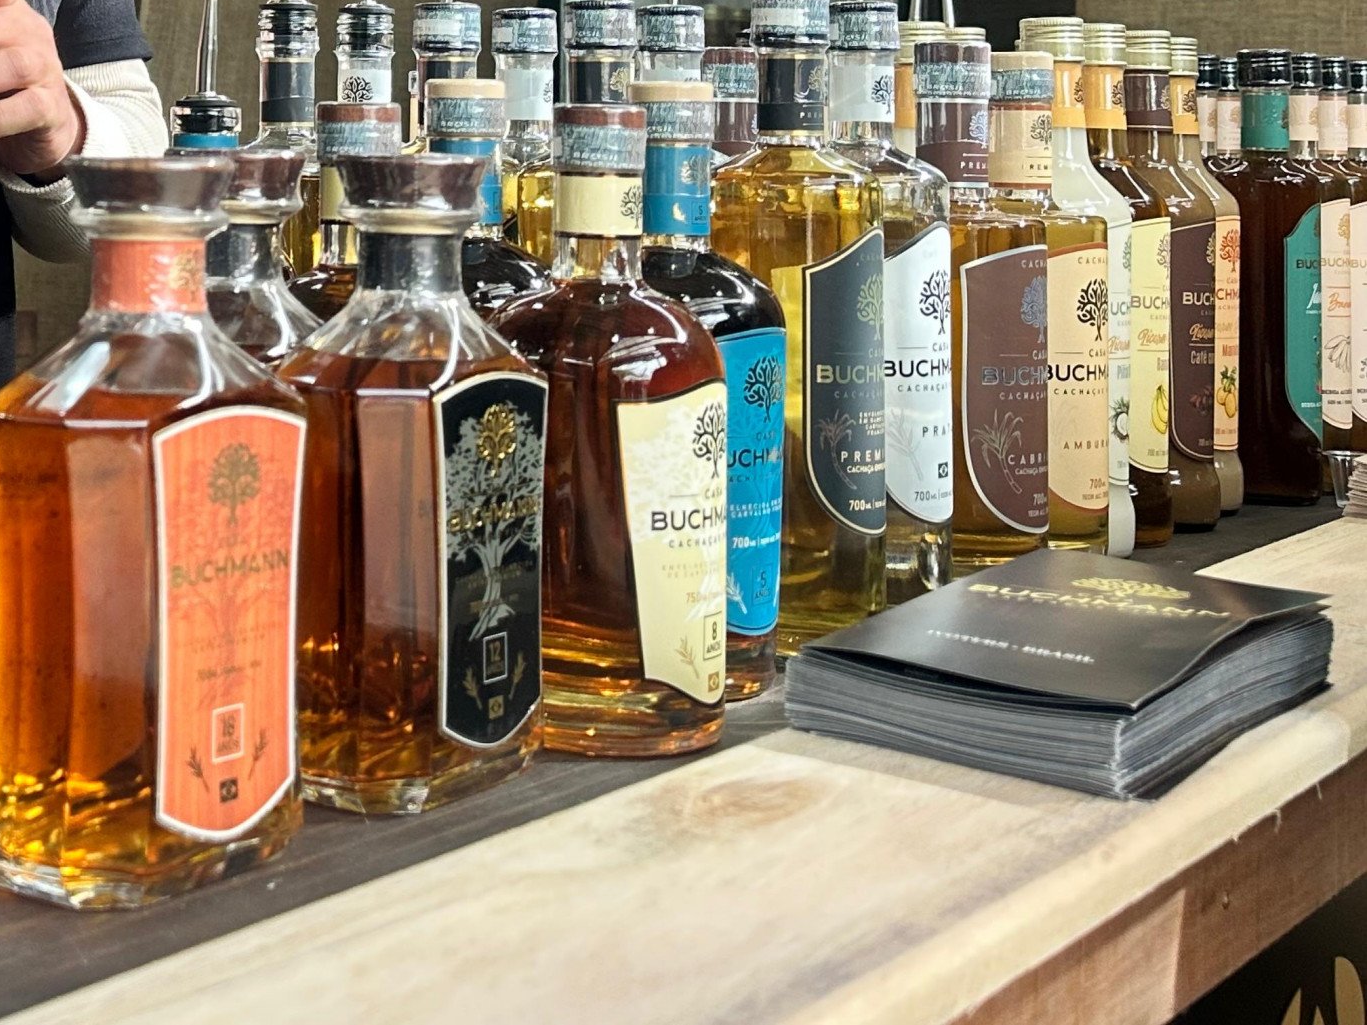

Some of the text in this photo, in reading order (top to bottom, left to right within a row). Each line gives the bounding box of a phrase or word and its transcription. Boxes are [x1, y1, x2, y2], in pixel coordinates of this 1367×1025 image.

[884, 358, 951, 378] BUCHM
[1047, 363, 1109, 382] BUCHM
[170, 548, 290, 589] BUCHMANN
[967, 583, 1231, 618] BUCHMANN
[711, 620, 718, 641] 8
[488, 641, 502, 663] 12
